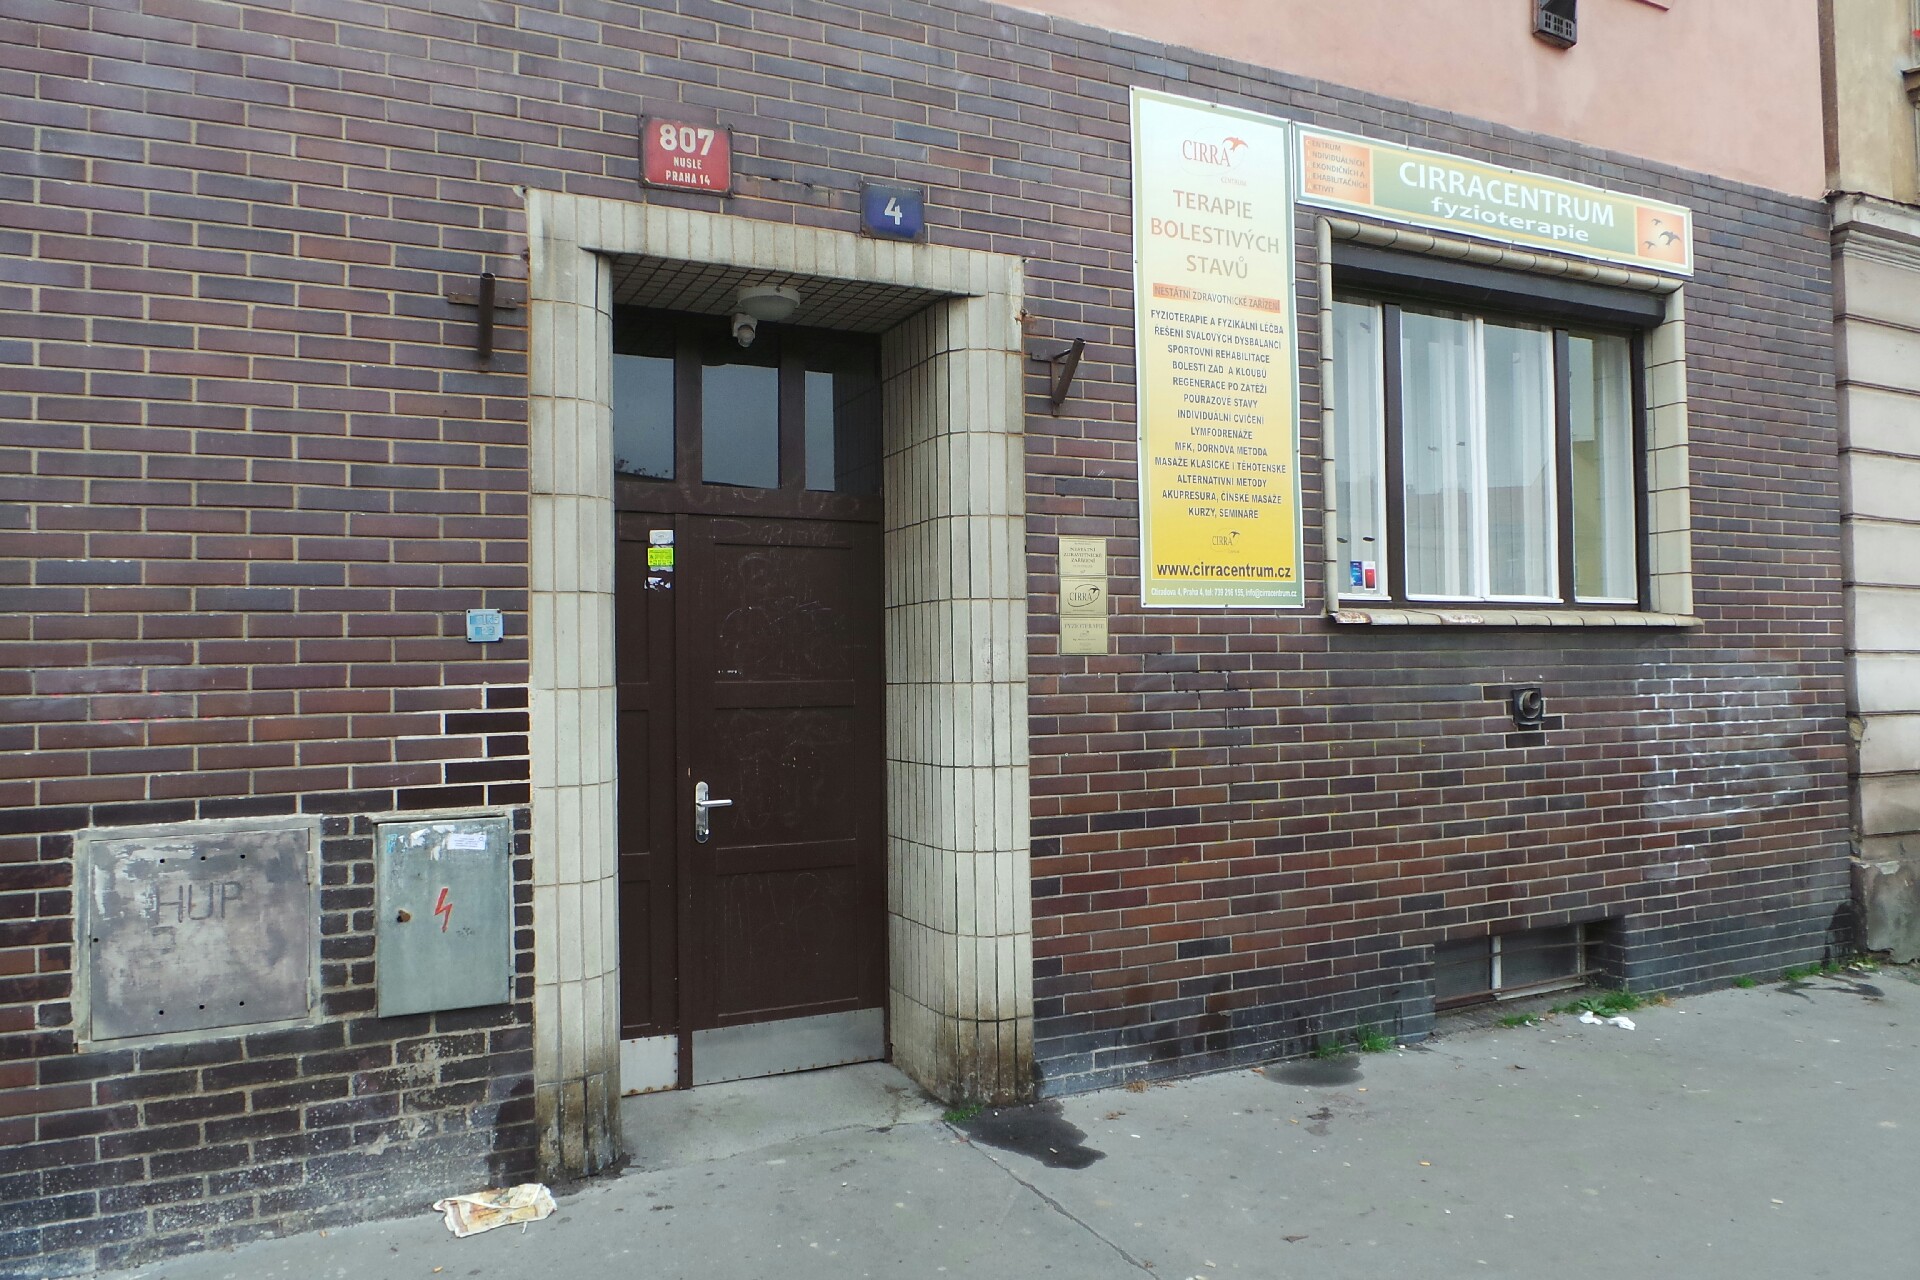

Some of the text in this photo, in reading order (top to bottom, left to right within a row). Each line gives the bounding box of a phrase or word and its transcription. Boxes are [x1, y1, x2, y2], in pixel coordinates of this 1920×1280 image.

[659, 124, 715, 156] 807
[1182, 139, 1231, 167] CIRRA
[673, 156, 702, 170] NUSLE
[666, 170, 711, 186] PRAHA 14
[1399, 160, 1616, 228] CIRRACENTRUM
[884, 197, 902, 225] 4
[1173, 189, 1253, 219] TERAPIE
[1430, 196, 1590, 242] fyzioterapie
[1151, 217, 1279, 254] BOLESTIVÝCH
[1186, 254, 1248, 279] STAVŮ
[1154, 285, 1280, 311] NESTÁTNÍ ZDRAVOTNICKÉ ZAŘÍZENÍ
[1151, 309, 1208, 325] FYZIOTERAPIE
[1210, 317, 1216, 326] A
[1259, 322, 1284, 335] LÉČBA
[1154, 323, 1184, 339] ŘEŠENÍ
[1185, 329, 1233, 344] SVALOVÝCH
[1215, 348, 1270, 364] REHABILITACE
[1172, 360, 1206, 372] BOLESTI
[1208, 363, 1224, 374] ZAD
[1228, 366, 1234, 375] A
[1172, 376, 1226, 390] REGENERACE
[1227, 379, 1239, 391] PO
[1234, 398, 1258, 409] STAVY
[1174, 441, 1268, 457] MFK, DORNOVA METODA
[1236, 477, 1267, 488] METODY
[1162, 489, 1219, 503] AKUPRESURA,
[1188, 507, 1217, 519] KURZY,
[1211, 535, 1233, 546] CIRRA
[1156, 562, 1291, 578] www.cirracentrum.cz
[1069, 591, 1093, 601] CIRRA
[1183, 587, 1199, 596] Praha
[154, 880, 243, 924] HUP
